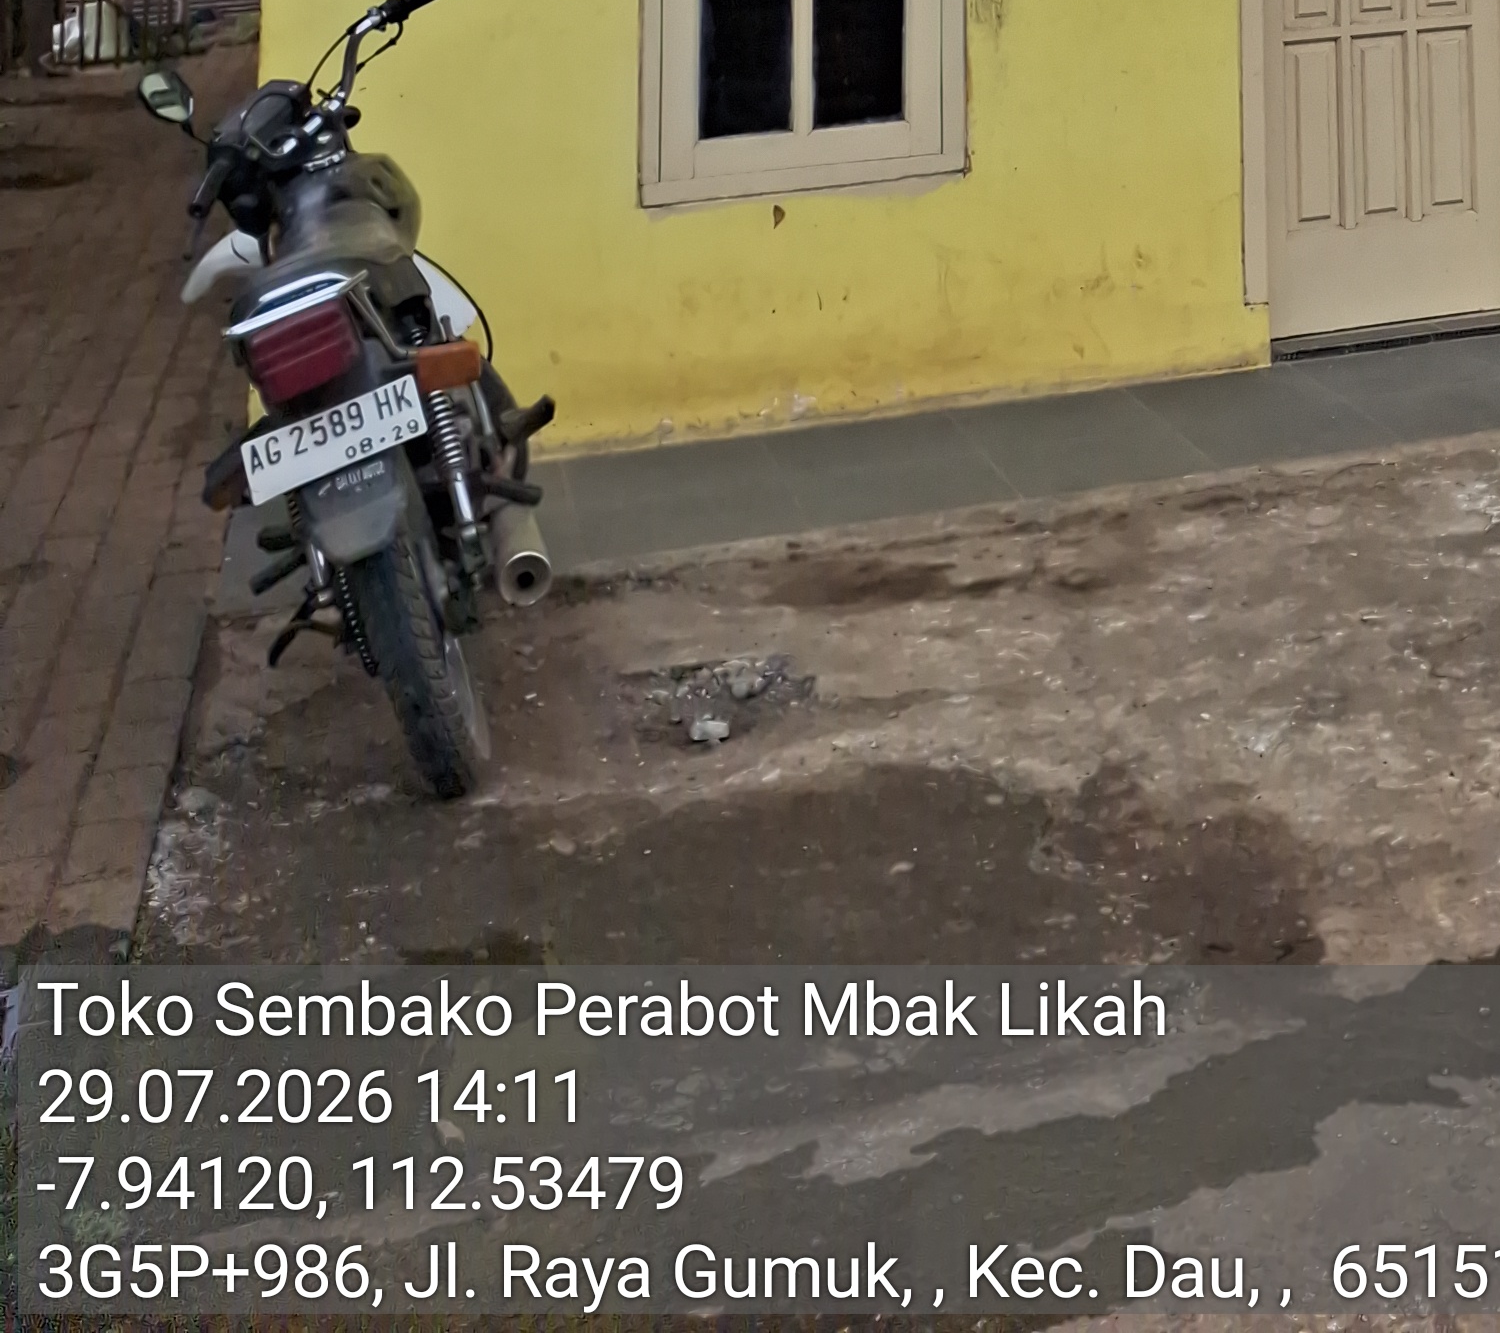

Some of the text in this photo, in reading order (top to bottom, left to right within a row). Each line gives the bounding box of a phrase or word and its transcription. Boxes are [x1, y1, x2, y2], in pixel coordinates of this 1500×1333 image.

[250, 380, 412, 475] AG 2589 HK
